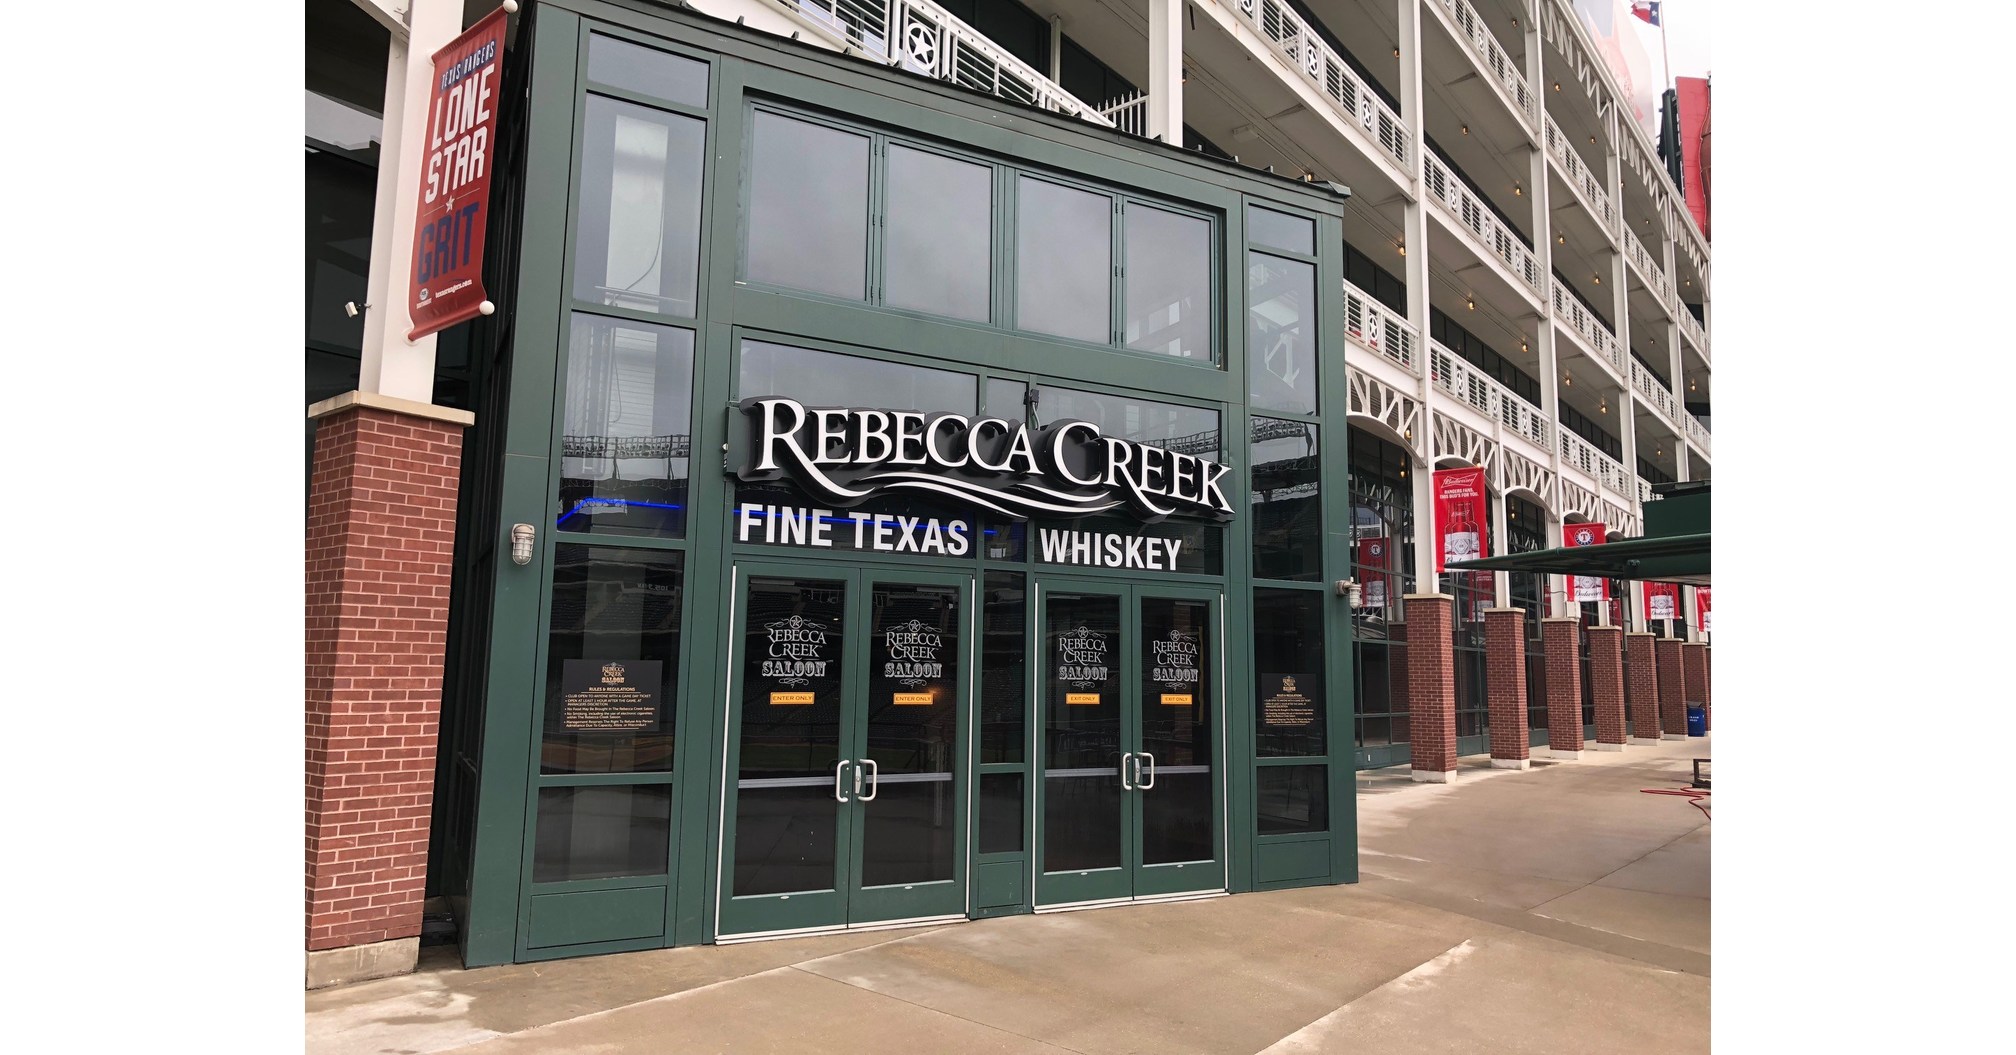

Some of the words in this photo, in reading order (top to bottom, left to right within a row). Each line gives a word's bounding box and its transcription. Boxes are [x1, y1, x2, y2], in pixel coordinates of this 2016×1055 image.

[441, 63, 461, 90] TEXAS
[463, 40, 495, 75] RANGERS
[431, 63, 495, 151] LONE
[424, 125, 488, 205] STAR
[417, 202, 480, 285] GRIT
[754, 398, 1044, 498] REBECCA
[1053, 421, 1236, 515] CREEK
[739, 502, 833, 548] FINE
[849, 511, 969, 555] TEXAS
[1040, 528, 1183, 571] WHISKEY
[767, 629, 827, 645] REBECCA
[886, 632, 943, 647] REBECCA
[1059, 638, 1107, 652] REBECCA
[769, 643, 820, 660] CREEK
[890, 645, 937, 662] CREEK
[1153, 640, 1197, 654] REBECCA
[1063, 650, 1103, 665] CREEK
[1157, 652, 1193, 667] CREEK
[762, 661, 826, 677] SALOON
[885, 663, 942, 678] SALOON
[1058, 666, 1108, 680] SALOON
[1152, 668, 1198, 682] SALOON
